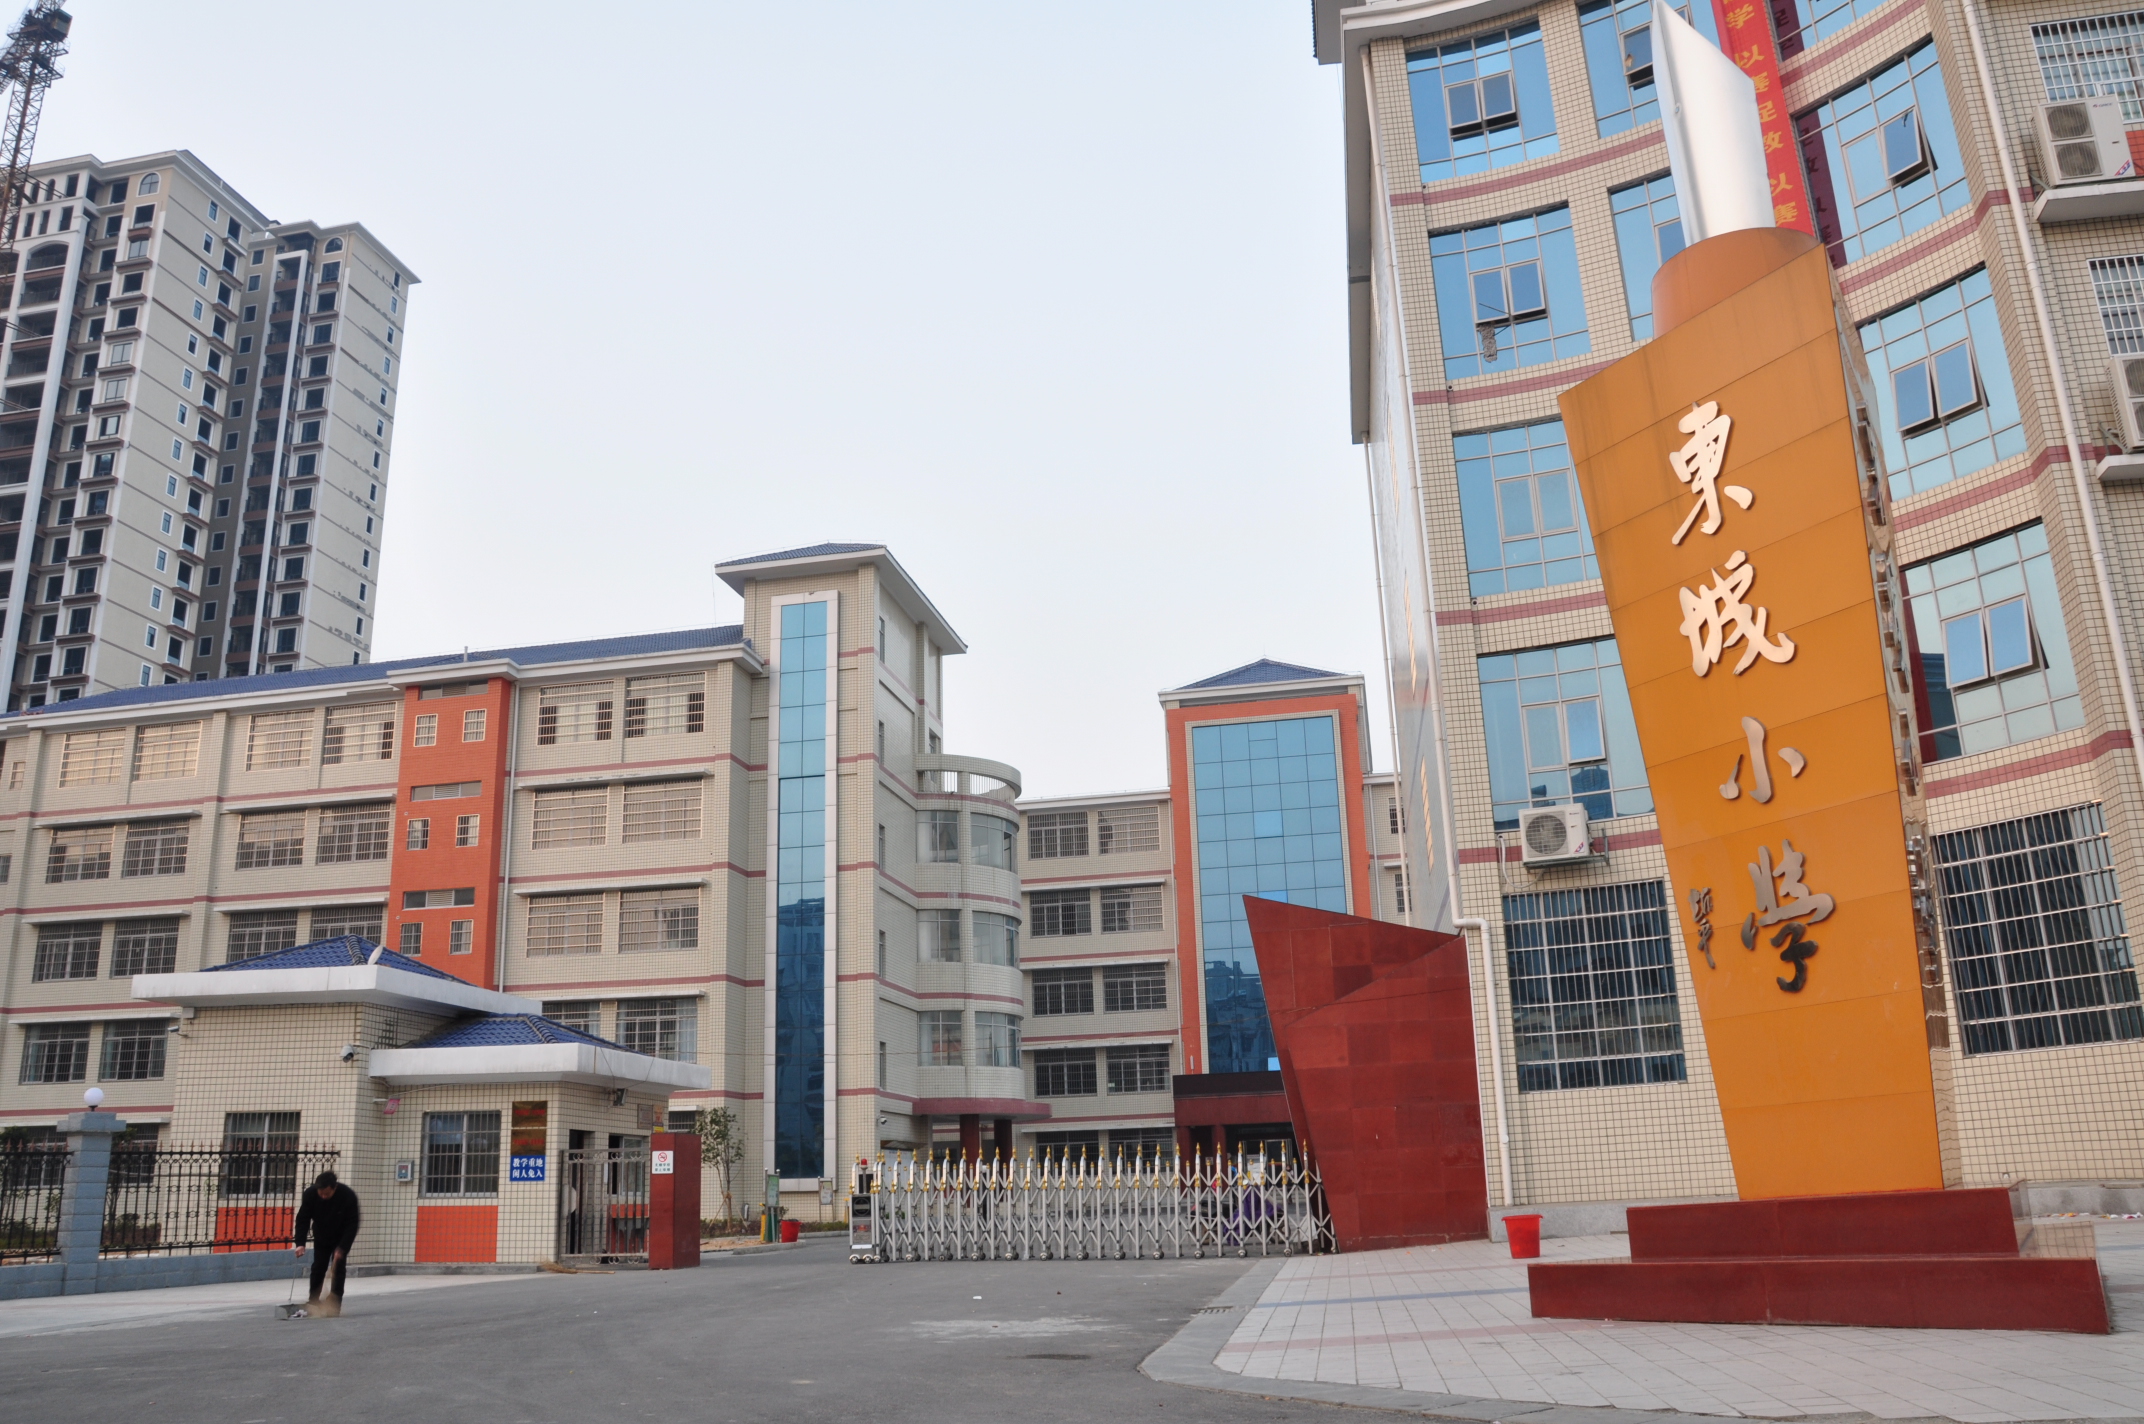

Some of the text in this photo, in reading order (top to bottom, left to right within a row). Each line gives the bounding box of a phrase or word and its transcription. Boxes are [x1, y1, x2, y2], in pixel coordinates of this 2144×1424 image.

[512, 1158, 544, 1168] 教学重地
[512, 1169, 543, 1179] 闲人免入
